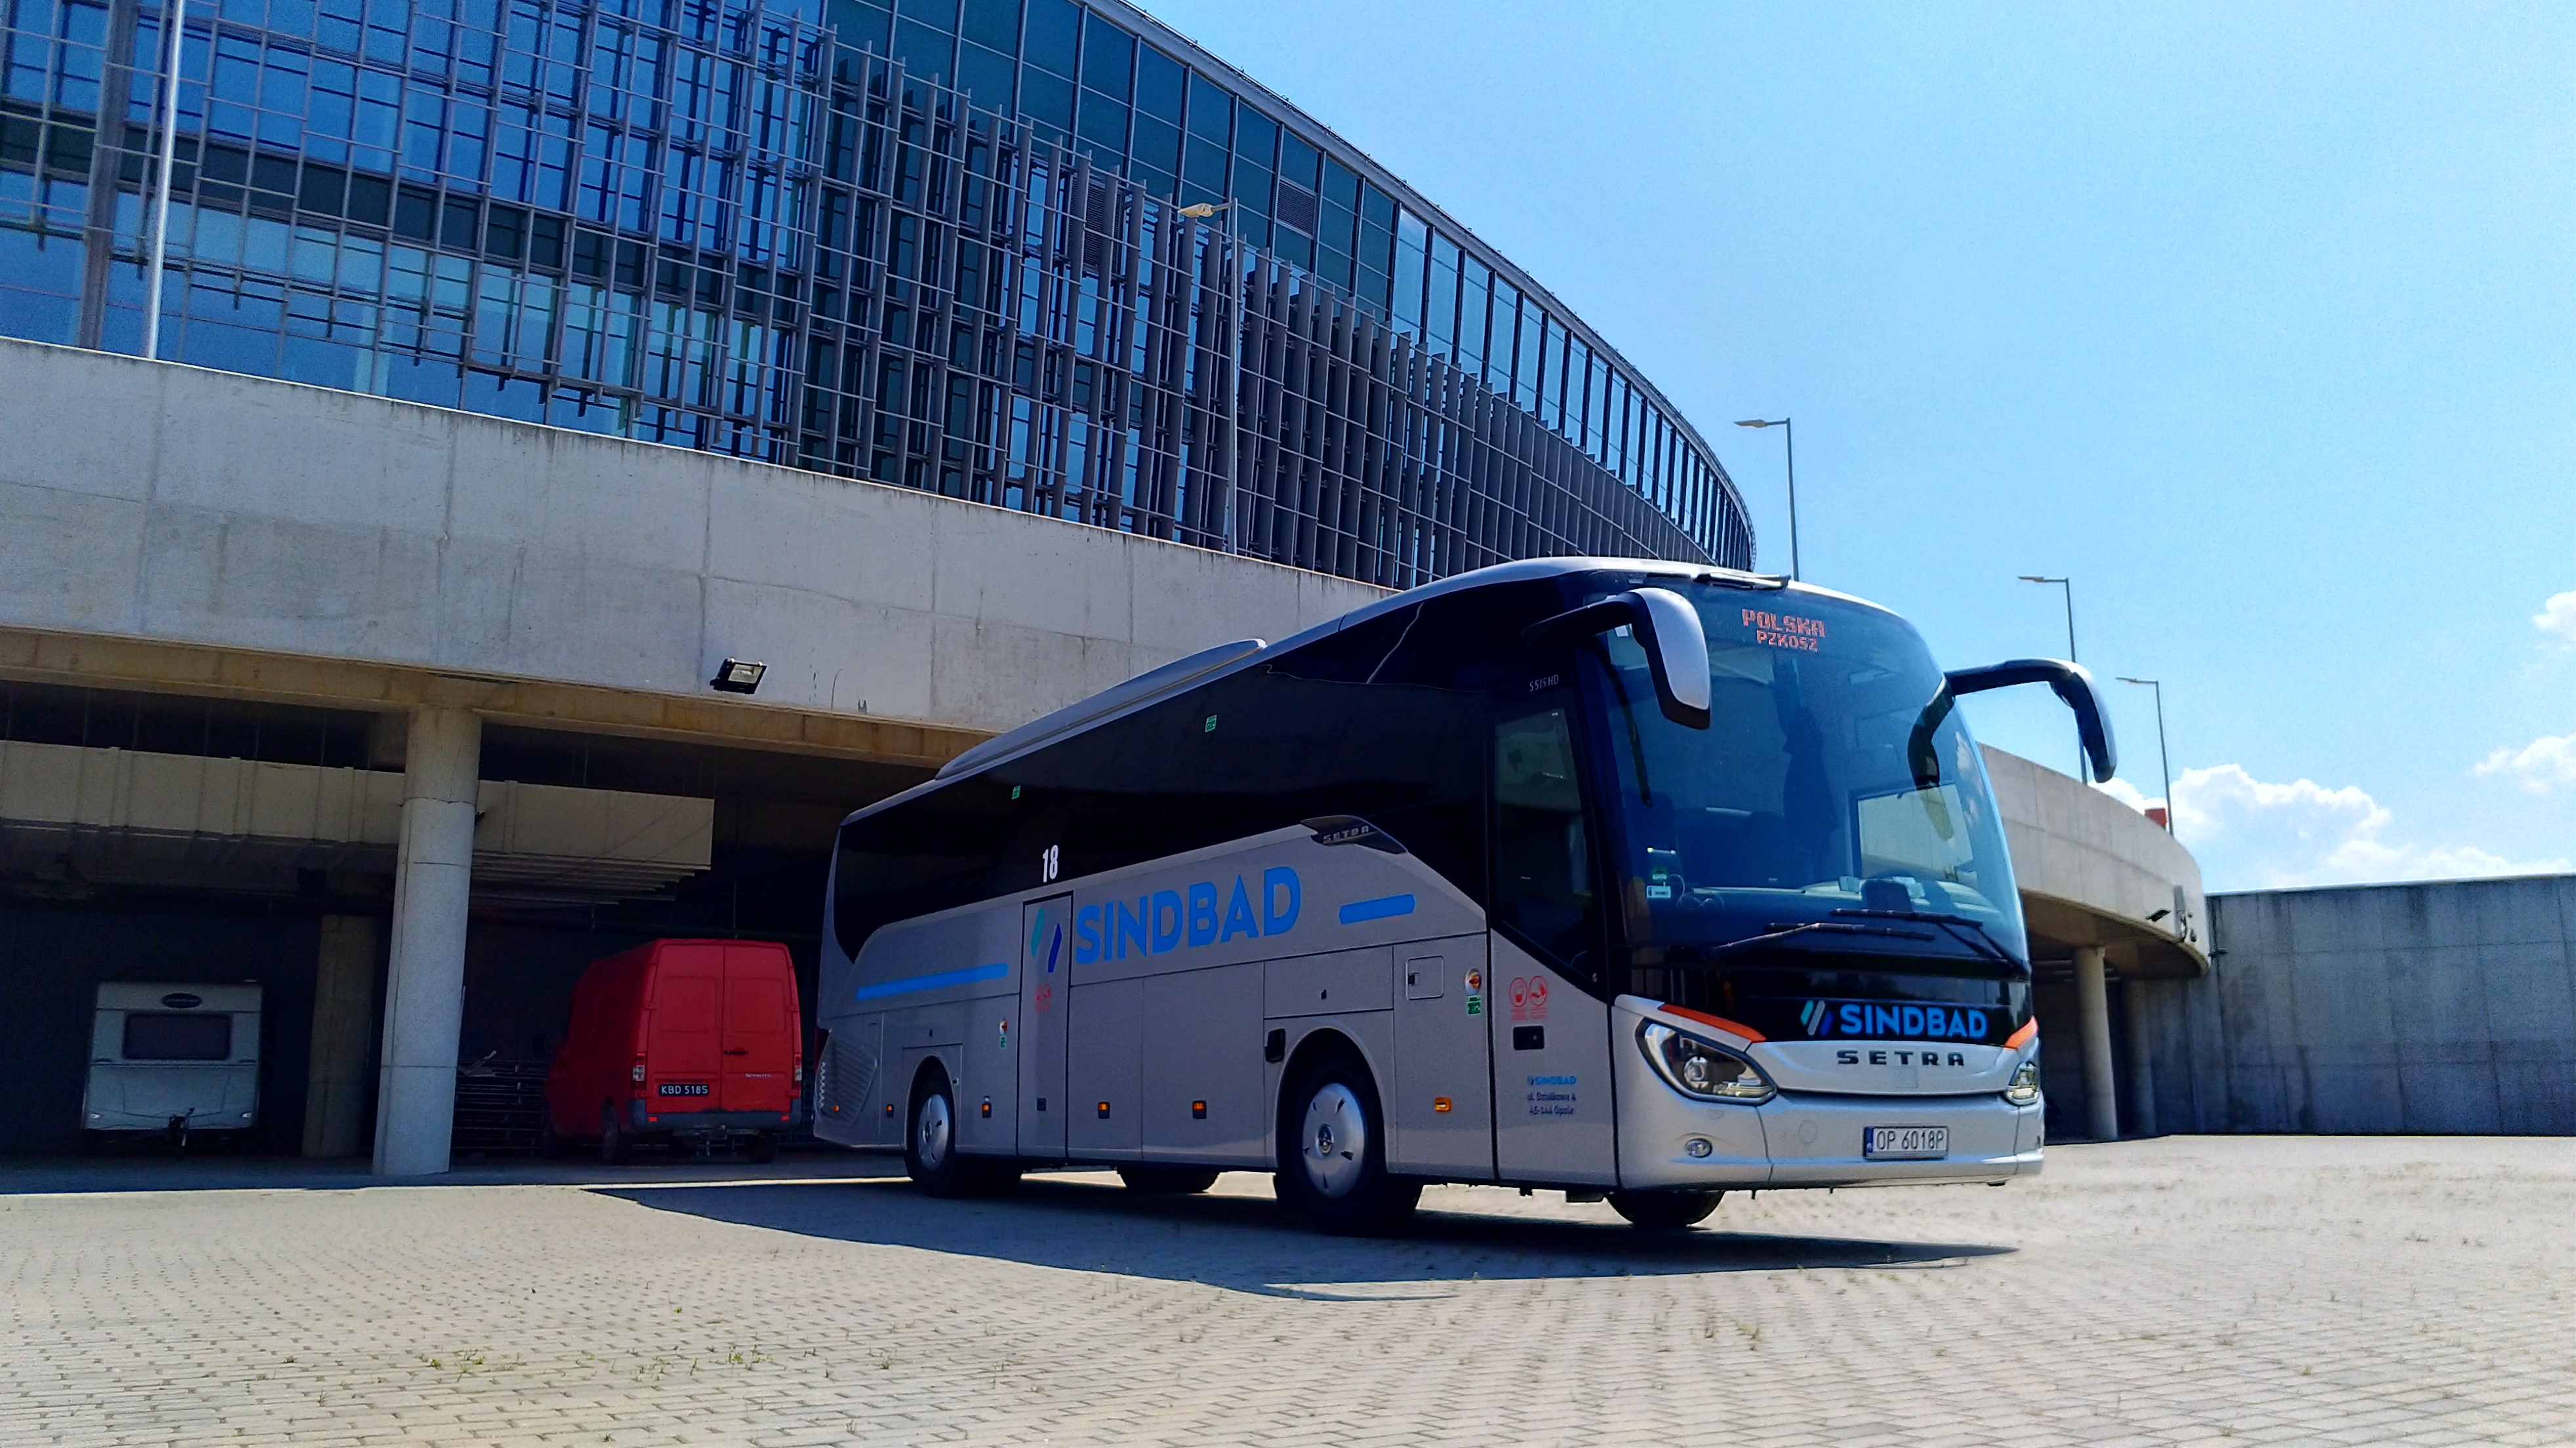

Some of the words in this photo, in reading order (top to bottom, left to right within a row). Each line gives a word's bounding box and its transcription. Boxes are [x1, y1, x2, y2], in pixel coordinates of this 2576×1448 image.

[1742, 609, 1826, 637] POLSKA
[1756, 630, 1818, 653] PZKOSZ
[1323, 825, 1369, 845] SETRA
[1043, 845, 1059, 883] 18
[1076, 866, 1301, 965] SINDBAD
[1840, 1003, 1988, 1037] SINDBAD
[1837, 1050, 1965, 1066] SETRA
[661, 1085, 681, 1095] KBD
[1876, 1130, 1897, 1150] OP
[1901, 1129, 1944, 1150] 6018P
